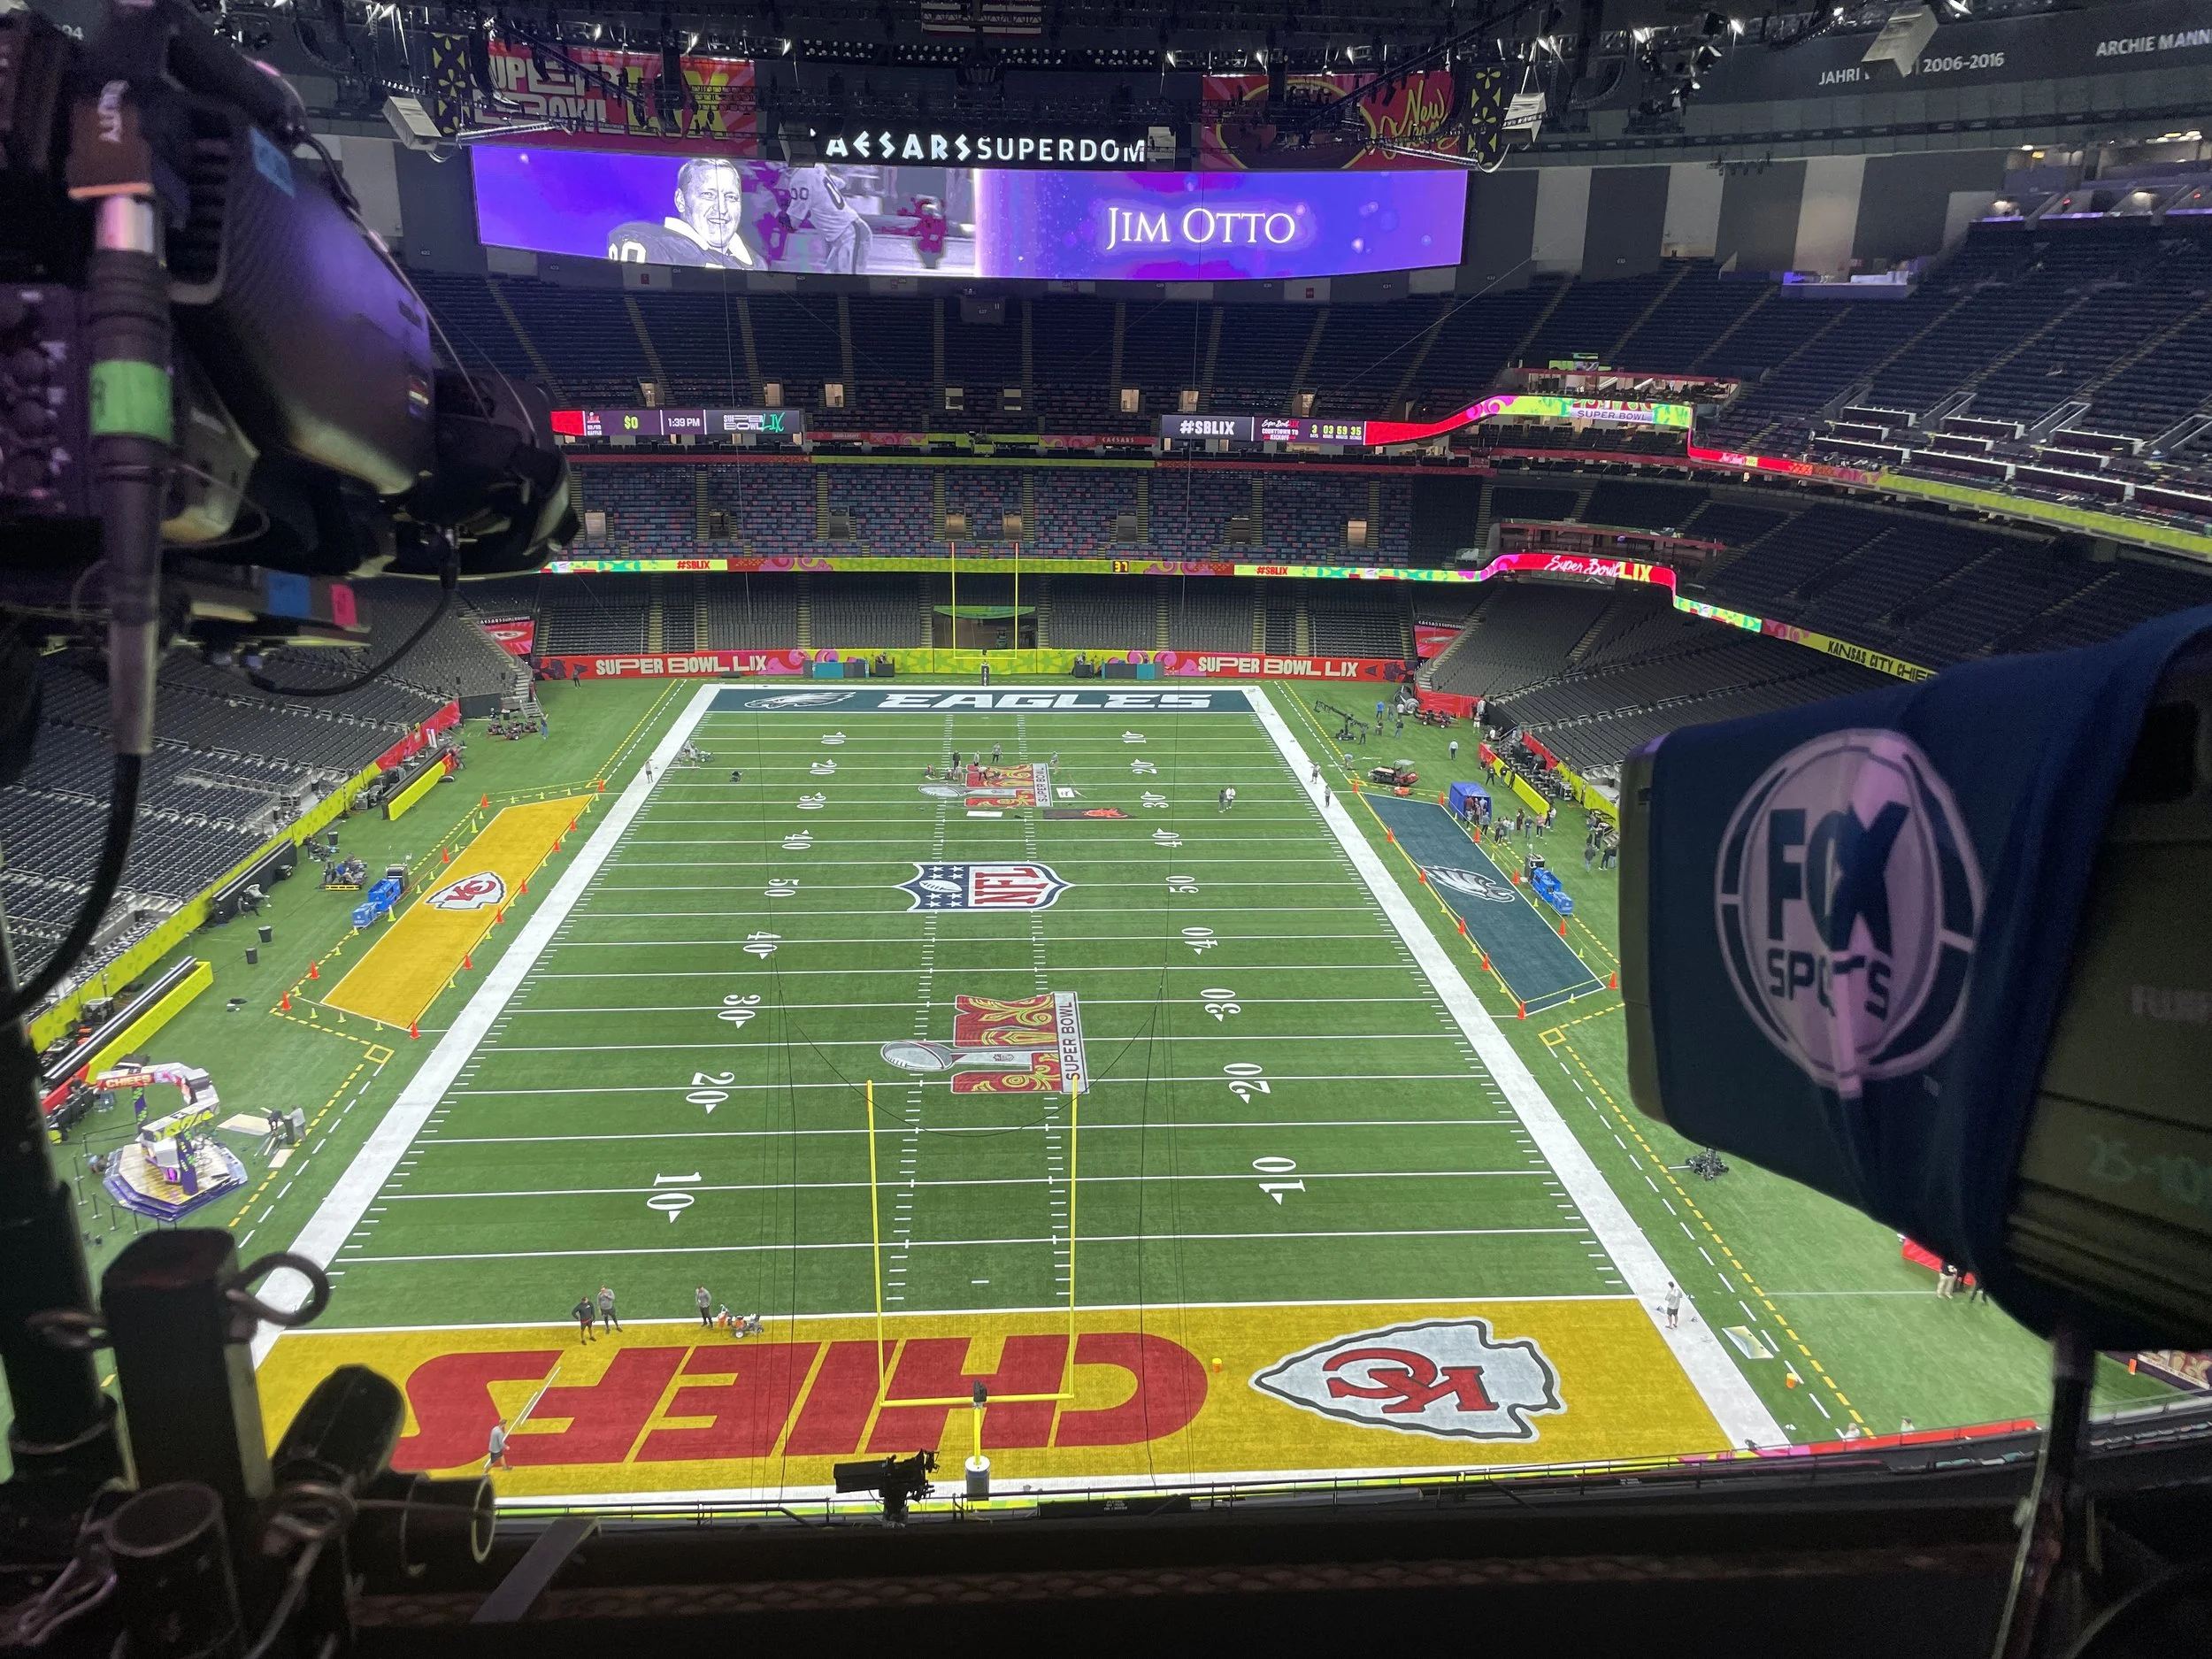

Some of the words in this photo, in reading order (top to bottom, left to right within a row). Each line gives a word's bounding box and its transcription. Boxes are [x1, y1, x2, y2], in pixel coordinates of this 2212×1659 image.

[2095, 36, 2155, 57] ARCHIE
[2158, 28, 2212, 50] MANN
[1923, 52, 2004, 73] 2006-2016
[1818, 68, 1860, 85] JAHRI
[625, 65, 729, 140] LX
[810, 129, 972, 162] AESARS
[977, 135, 1146, 163] SUPERDOM
[1107, 207, 1171, 250] JIM
[1183, 208, 1295, 244] OTTO
[624, 415, 639, 430] $0
[667, 418, 686, 427] 1:39
[687, 418, 700, 427] PM
[724, 422, 764, 431] BOWL
[761, 411, 786, 433] LIX
[1578, 410, 1617, 420] SUPER
[1618, 412, 1648, 422] BOWL
[1179, 419, 1235, 435] #SBLIX
[1311, 425, 1317, 434] 3
[1323, 425, 1334, 434] 03
[677, 560, 710, 570] #SBLIX
[1114, 561, 1128, 572] 37
[1256, 566, 1288, 575] #SBLIX
[1620, 562, 1653, 582] LIX
[596, 658, 664, 676] SUPER
[668, 656, 729, 674] BOWL
[733, 654, 768, 672] LIX
[1198, 657, 1260, 674] SUPER
[1264, 658, 1321, 677] BOWL
[1325, 660, 1358, 679] LIX
[1828, 641, 1866, 664] KANSAS
[1870, 655, 1893, 672] CITY
[1897, 663, 1930, 681] CHIE
[877, 694, 1212, 709] EAGLES
[1122, 733, 1147, 743] 10
[810, 762, 837, 774] 20
[1131, 762, 1157, 774] 20
[797, 795, 826, 810] 30
[1141, 794, 1169, 808] 30
[781, 833, 814, 849] 40
[1152, 831, 1182, 848] 40
[764, 879, 799, 896] 50
[975, 868, 1049, 904] NFL
[1165, 875, 1199, 894] 50
[1768, 801, 1909, 959] FOX
[742, 931, 781, 954] 40
[1181, 927, 1217, 949] 40
[1767, 949, 1891, 1022] SPS
[718, 994, 761, 1021] 30
[1201, 988, 1241, 1014] 30
[1059, 1002, 1074, 1034] BOWL
[1063, 1039, 1080, 1080] SUPER
[106, 1074, 151, 1088] CHIEFS
[686, 1071, 735, 1104] 20
[1224, 1063, 1271, 1094] 20
[1253, 1156, 1306, 1193] 10
[647, 1171, 702, 1210] 10
[390, 1332, 1208, 1471] CHIEFS
